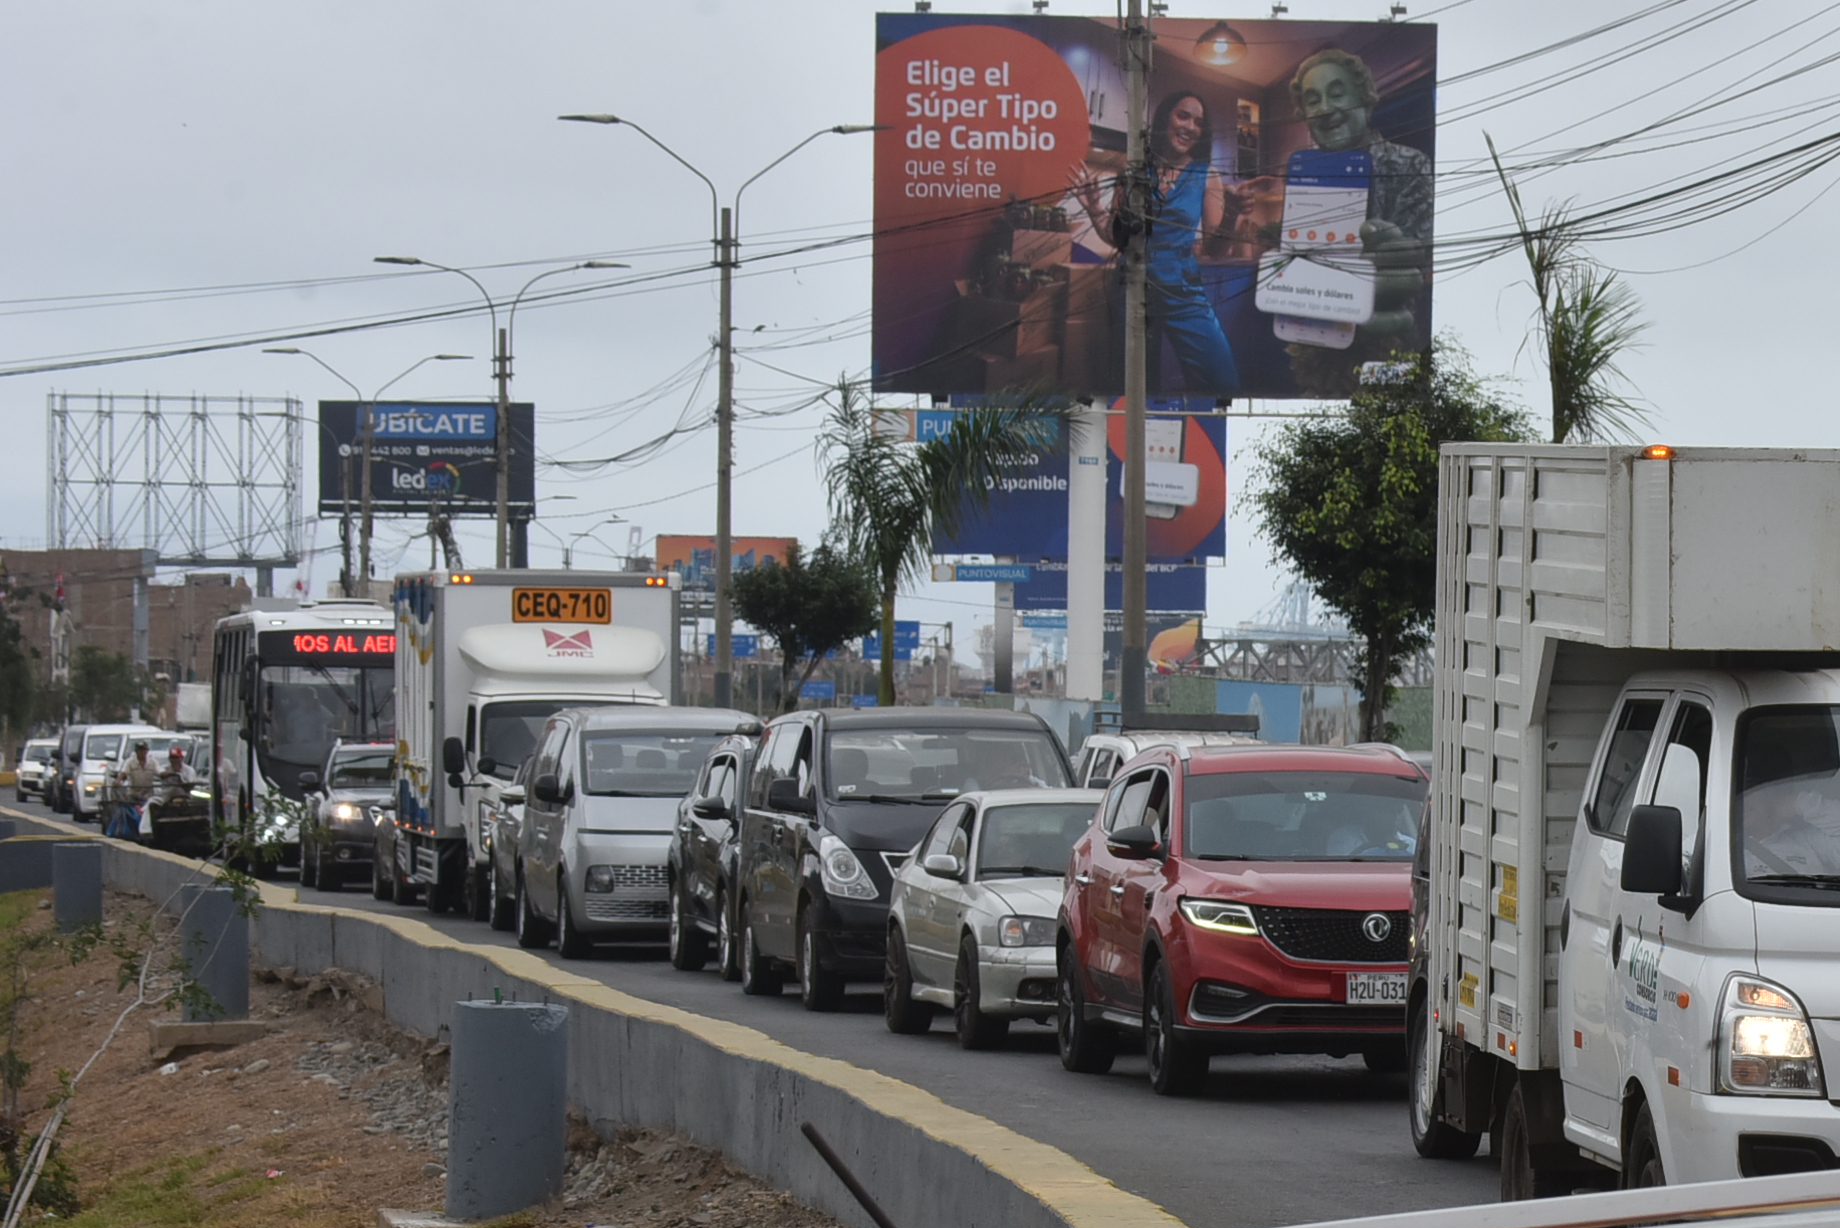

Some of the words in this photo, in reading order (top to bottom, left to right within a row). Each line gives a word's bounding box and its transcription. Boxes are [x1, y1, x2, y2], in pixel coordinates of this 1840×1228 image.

[907, 59, 976, 92] Elige
[984, 61, 1010, 87] el
[906, 90, 989, 124] Súper
[996, 93, 1058, 125] Tipo
[905, 123, 941, 149] de
[950, 124, 1056, 151] Cambio
[905, 159, 946, 180] que
[952, 155, 970, 176] sí
[975, 157, 997, 177] te
[905, 178, 1002, 199] conviene
[1295, 285, 1316, 296] soles
[368, 407, 486, 435] UBÍCATE
[983, 473, 1068, 494] Dsponible
[958, 567, 1028, 580] PUNTOVISUAL
[516, 592, 608, 618] CEQ-710
[333, 634, 359, 653] AL
[1349, 981, 1407, 1001] H2U-031
